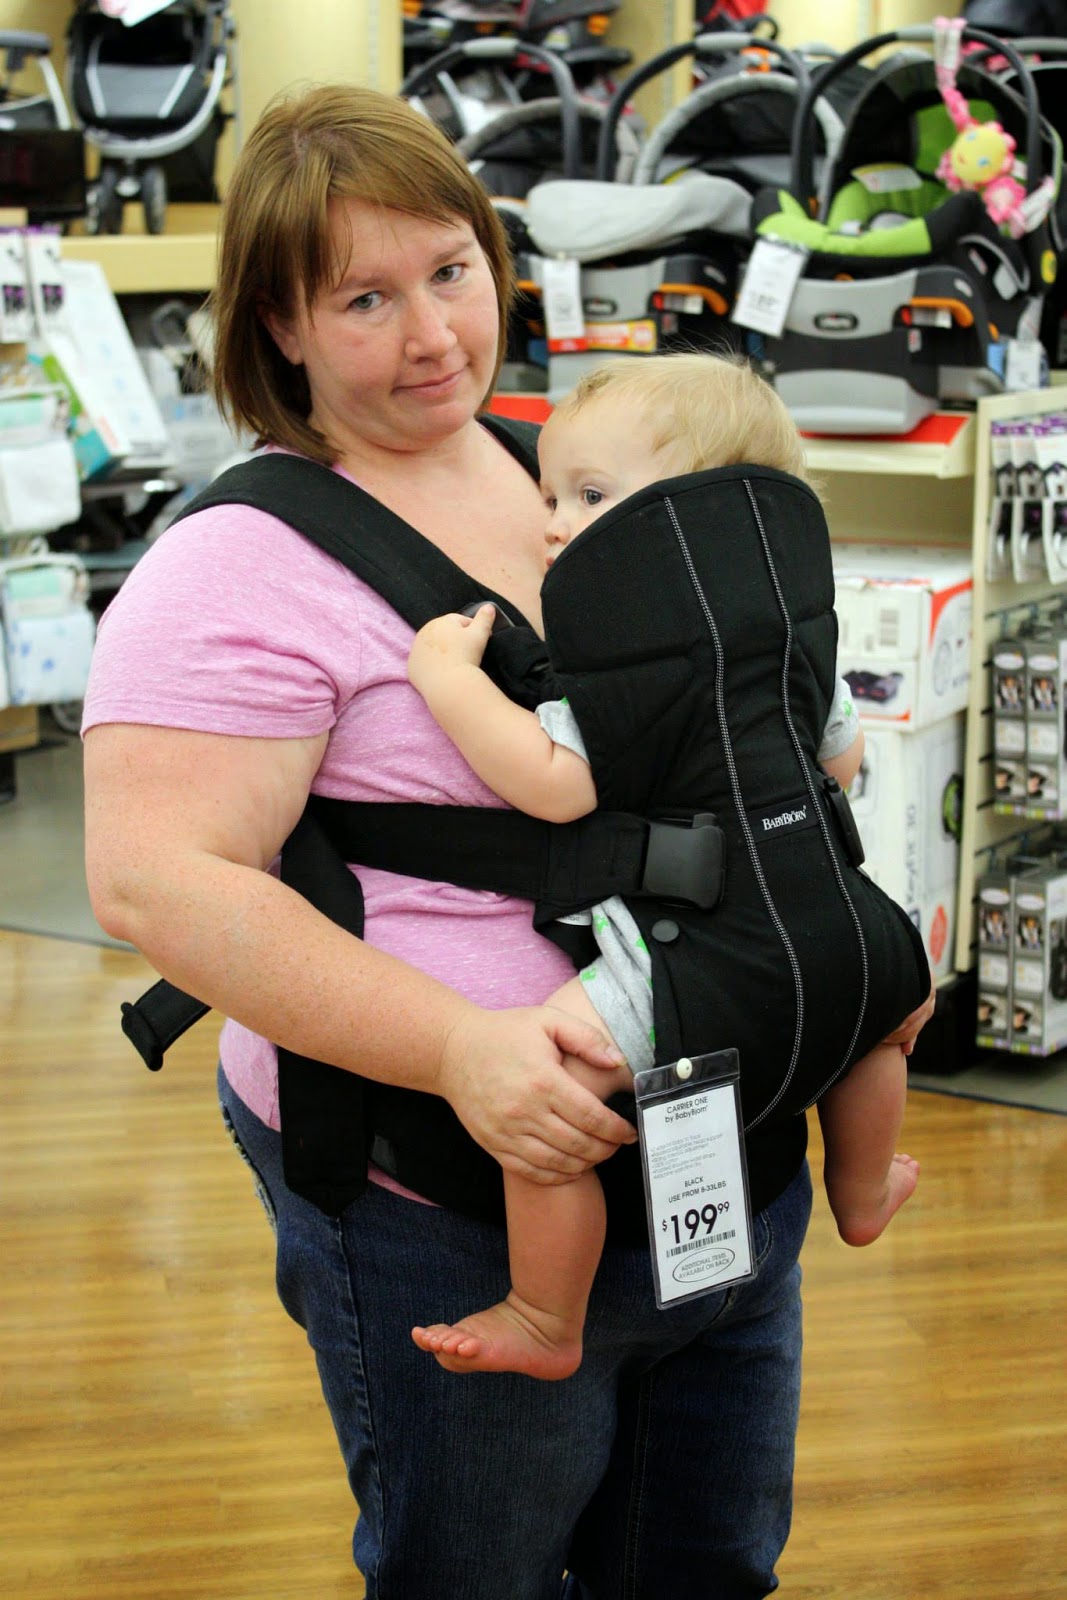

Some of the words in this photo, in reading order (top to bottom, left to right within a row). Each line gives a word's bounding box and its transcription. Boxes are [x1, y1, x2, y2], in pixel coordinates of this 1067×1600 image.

[667, 1101, 693, 1114] CARRIER
[694, 1096, 708, 1106] ONE
[684, 1176, 704, 1188] BLACK
[668, 1194, 681, 1203] USE
[682, 1188, 700, 1199] FROM
